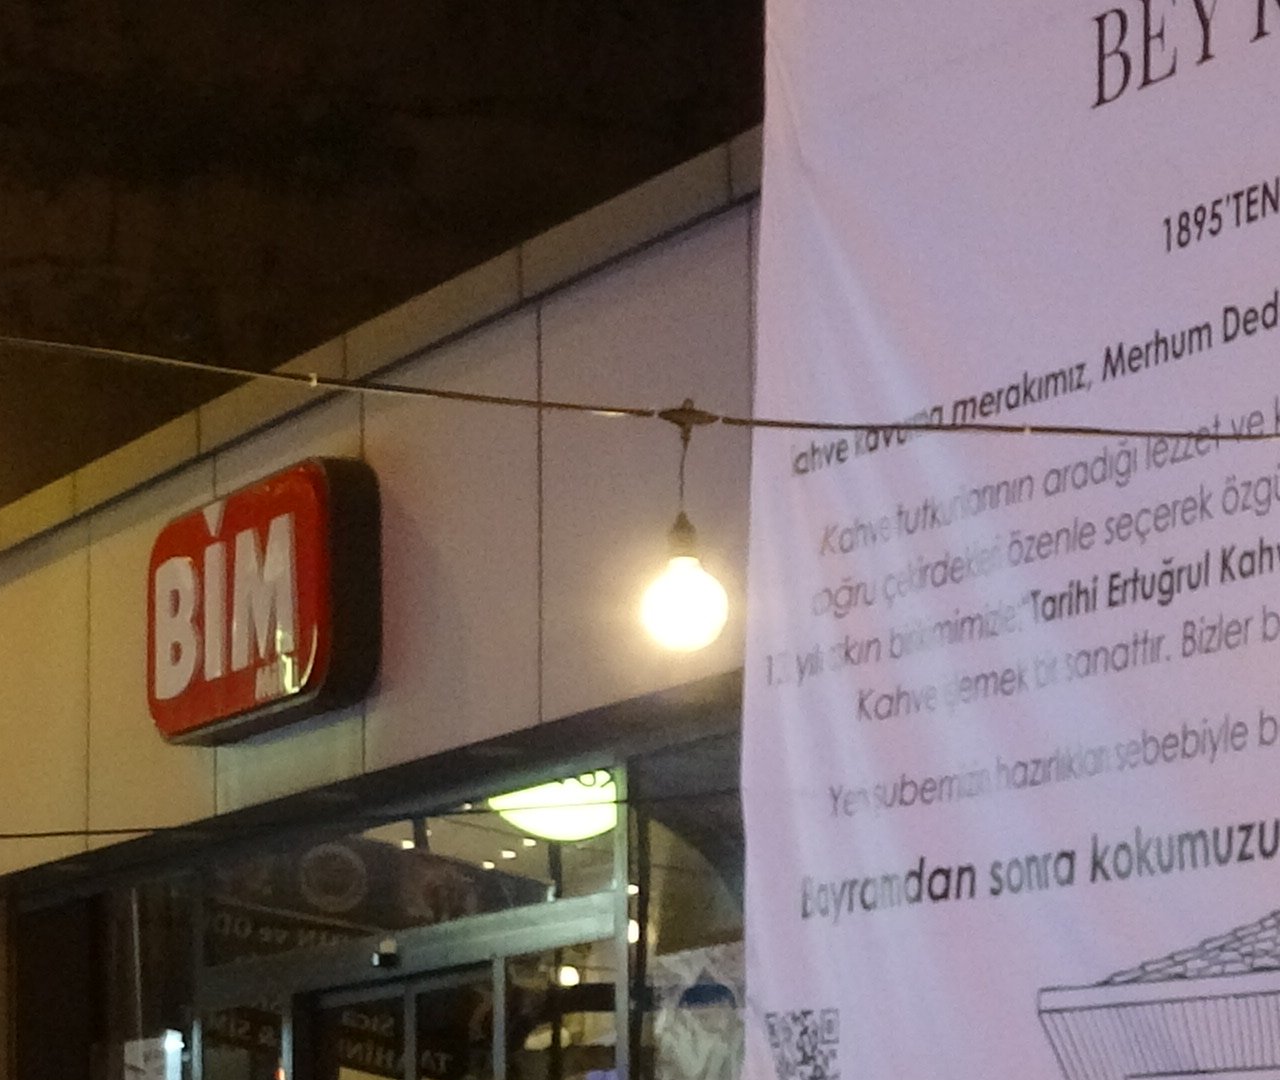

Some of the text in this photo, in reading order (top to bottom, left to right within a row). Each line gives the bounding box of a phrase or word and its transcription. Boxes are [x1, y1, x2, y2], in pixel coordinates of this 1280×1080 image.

[1102, 321, 1213, 381] Merhum
[1042, 438, 1138, 497] aradığı
[1230, 410, 1265, 443] ve
[1007, 516, 1096, 568] özenle
[1104, 483, 1214, 545] seçerek
[154, 499, 299, 701] BİM
[1107, 549, 1211, 607] Ertuğrul
[1181, 611, 1253, 658] Bizler
[989, 848, 1076, 898] sonra
